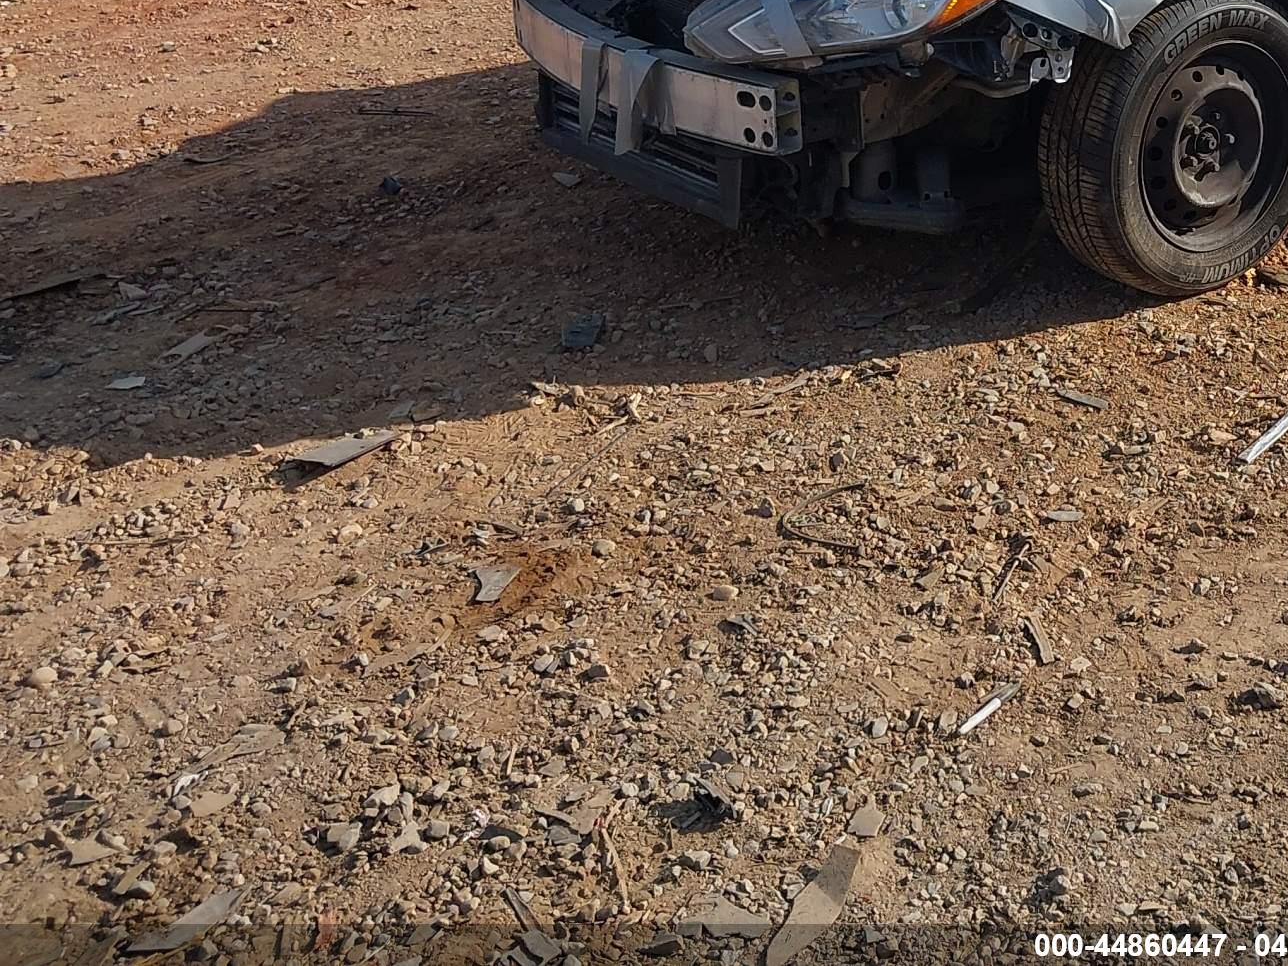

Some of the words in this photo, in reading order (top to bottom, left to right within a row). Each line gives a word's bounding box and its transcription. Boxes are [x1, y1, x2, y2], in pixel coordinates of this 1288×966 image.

[1163, 12, 1223, 65] GREEN
[1228, 9, 1270, 31] MAX
[1201, 224, 1281, 284] OPTIMUM
